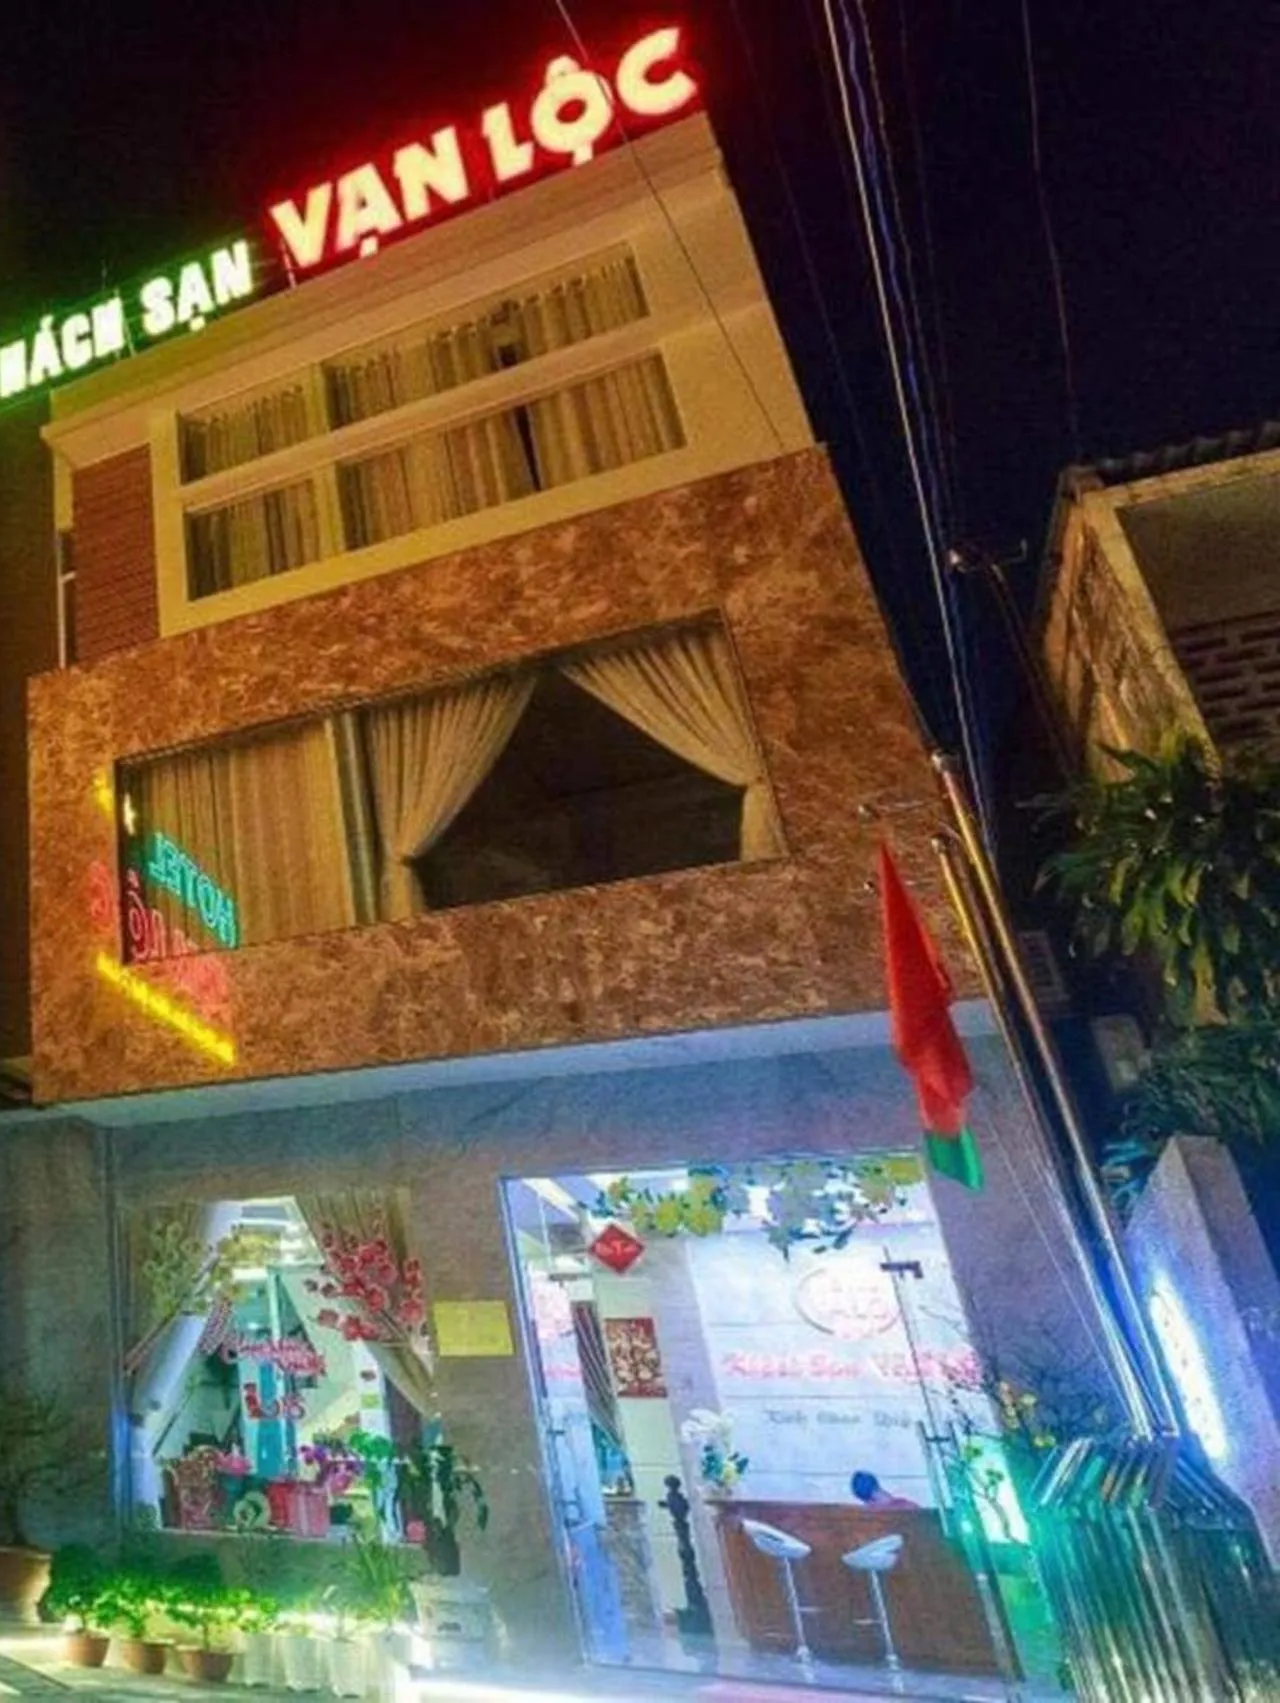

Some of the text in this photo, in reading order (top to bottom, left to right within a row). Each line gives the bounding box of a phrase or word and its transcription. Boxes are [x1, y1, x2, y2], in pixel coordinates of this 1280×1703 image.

[139, 239, 254, 333] SẠN
[270, 126, 470, 270] VẠN
[480, 27, 699, 183] LỘC
